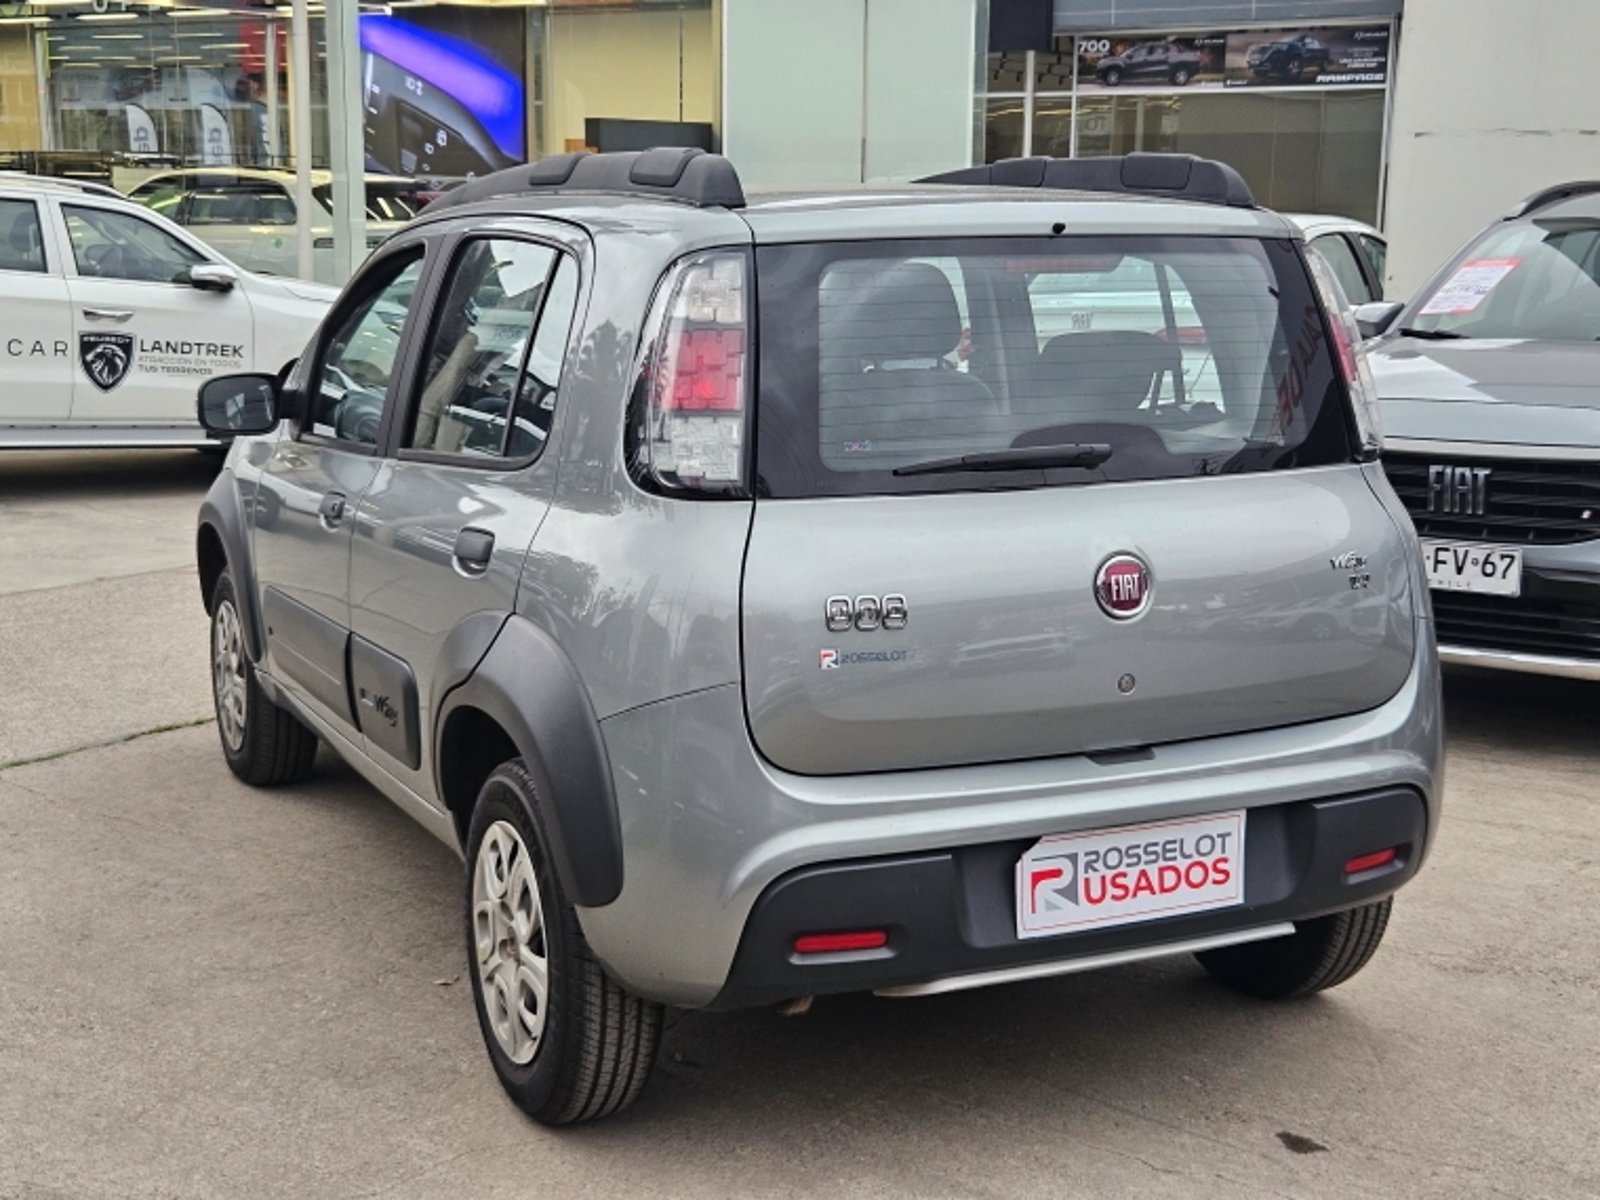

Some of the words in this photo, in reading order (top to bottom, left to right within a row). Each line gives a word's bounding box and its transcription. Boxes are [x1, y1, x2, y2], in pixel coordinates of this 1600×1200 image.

[1079, 40, 1110, 53] 700
[7, 339, 69, 357] CAR
[139, 339, 245, 359] LANDTREK
[1428, 465, 1492, 514] FIAT
[1110, 572, 1140, 602] FIAT
[1083, 832, 1232, 875] ROSSELOT
[1083, 857, 1231, 906] USADOS
